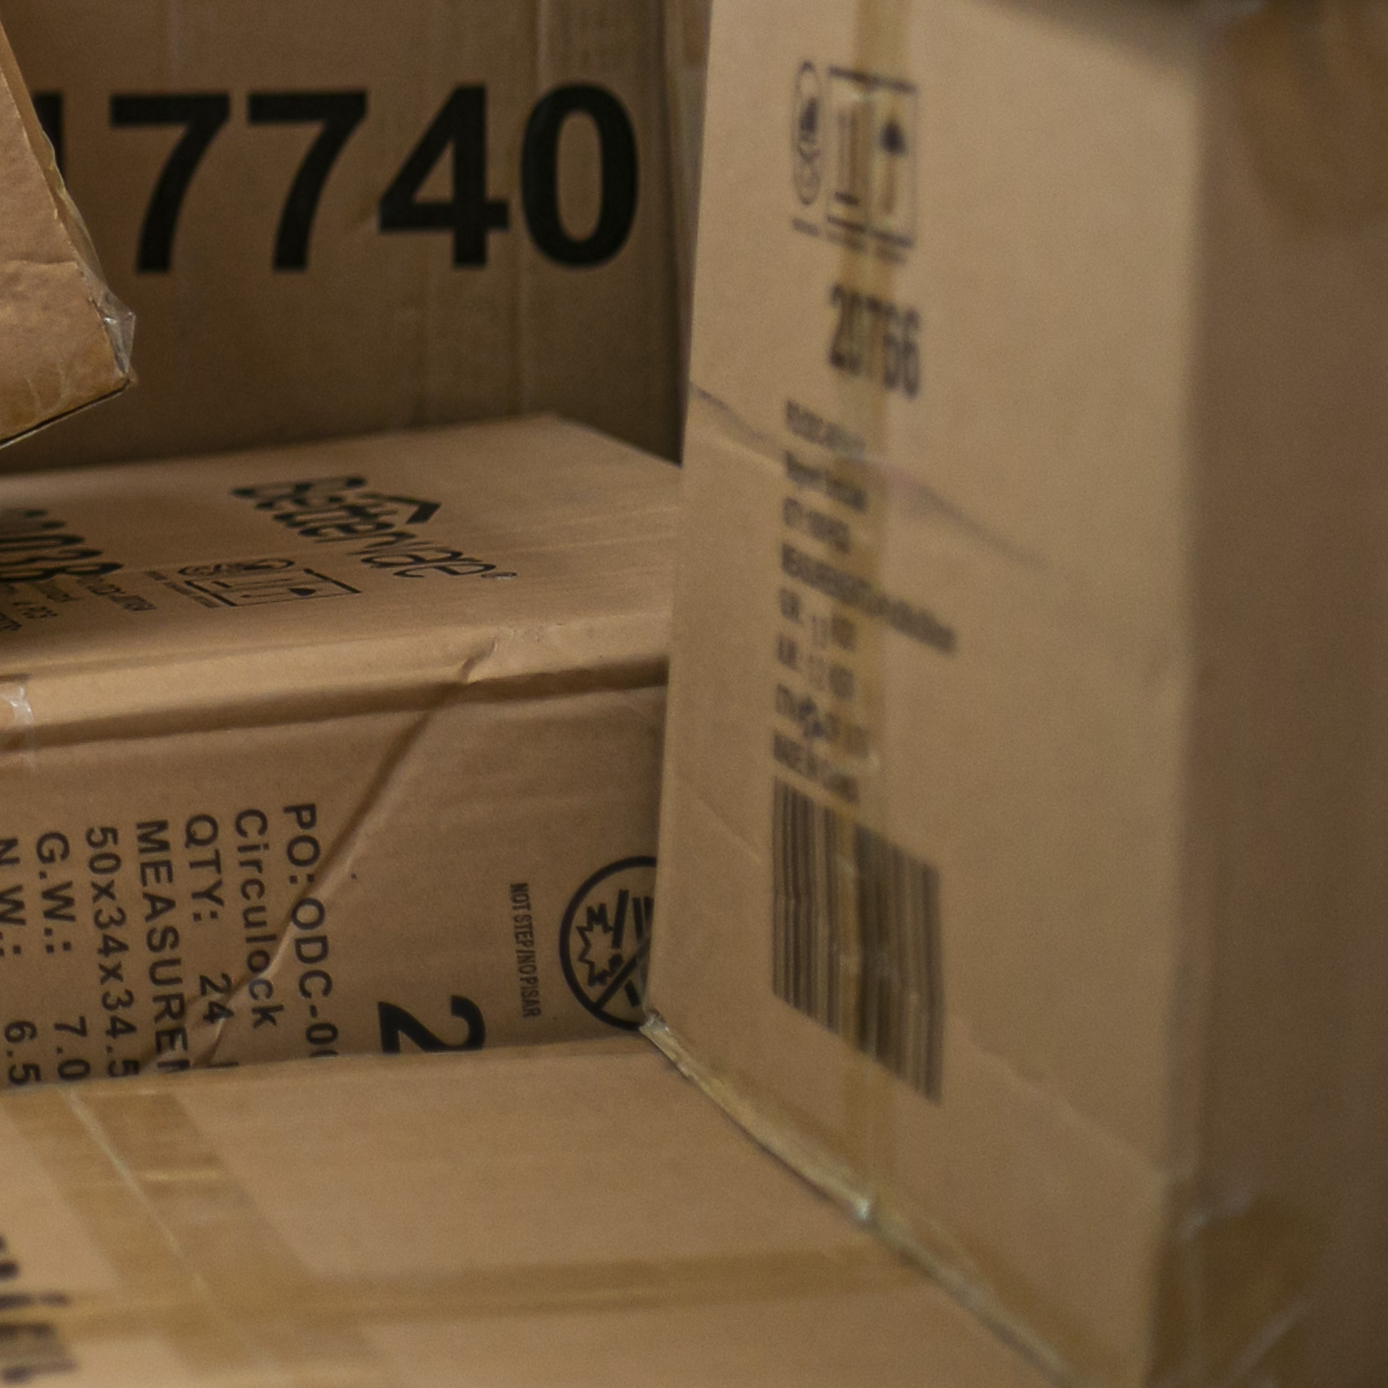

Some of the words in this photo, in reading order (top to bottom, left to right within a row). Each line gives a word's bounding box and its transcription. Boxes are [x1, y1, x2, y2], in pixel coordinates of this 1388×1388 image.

[185, 814, 224, 923] QTY:
[283, 803, 320, 886] PO:
[35, 831, 77, 955] G.W.:
[234, 808, 284, 1029] Circulock
[199, 972, 235, 1025] 24
[291, 897, 339, 1058] ODC-0
[4, 1020, 43, 1087] 6.5
[54, 1015, 91, 1081] 7.0
